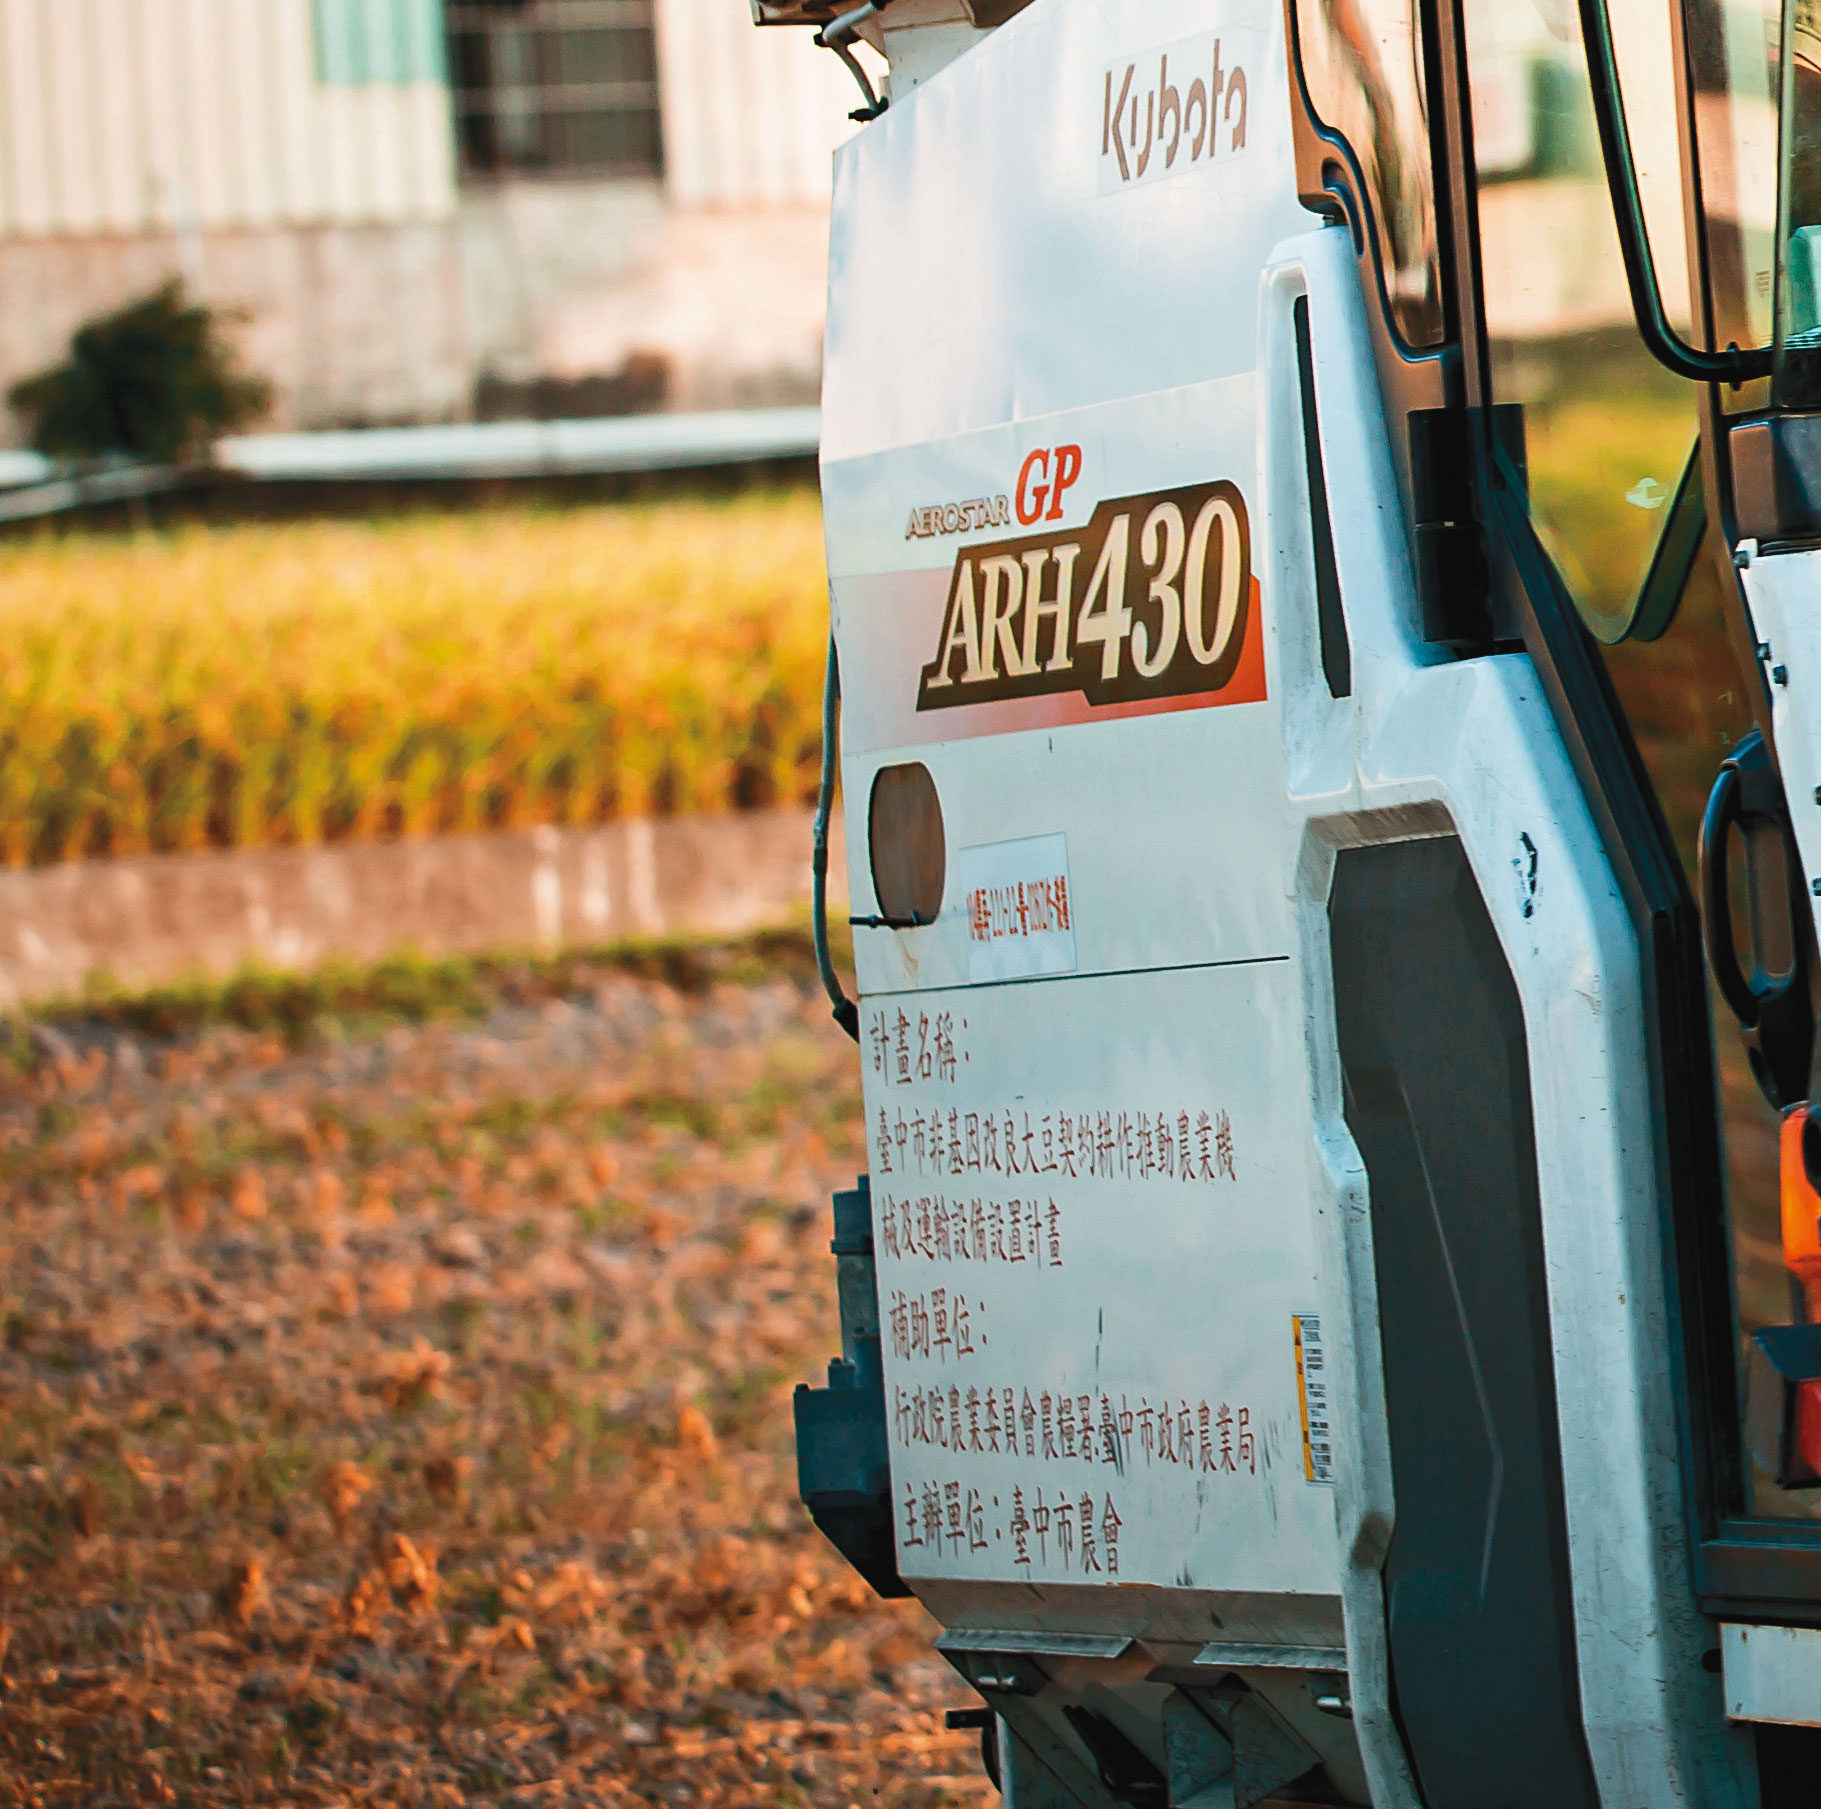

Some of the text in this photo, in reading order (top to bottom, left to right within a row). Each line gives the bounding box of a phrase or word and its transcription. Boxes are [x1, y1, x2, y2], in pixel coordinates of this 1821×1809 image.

[1102, 38, 1248, 182] Kubota
[905, 443, 1082, 540] AEROSTAR GP
[926, 495, 1241, 689] ARH430
